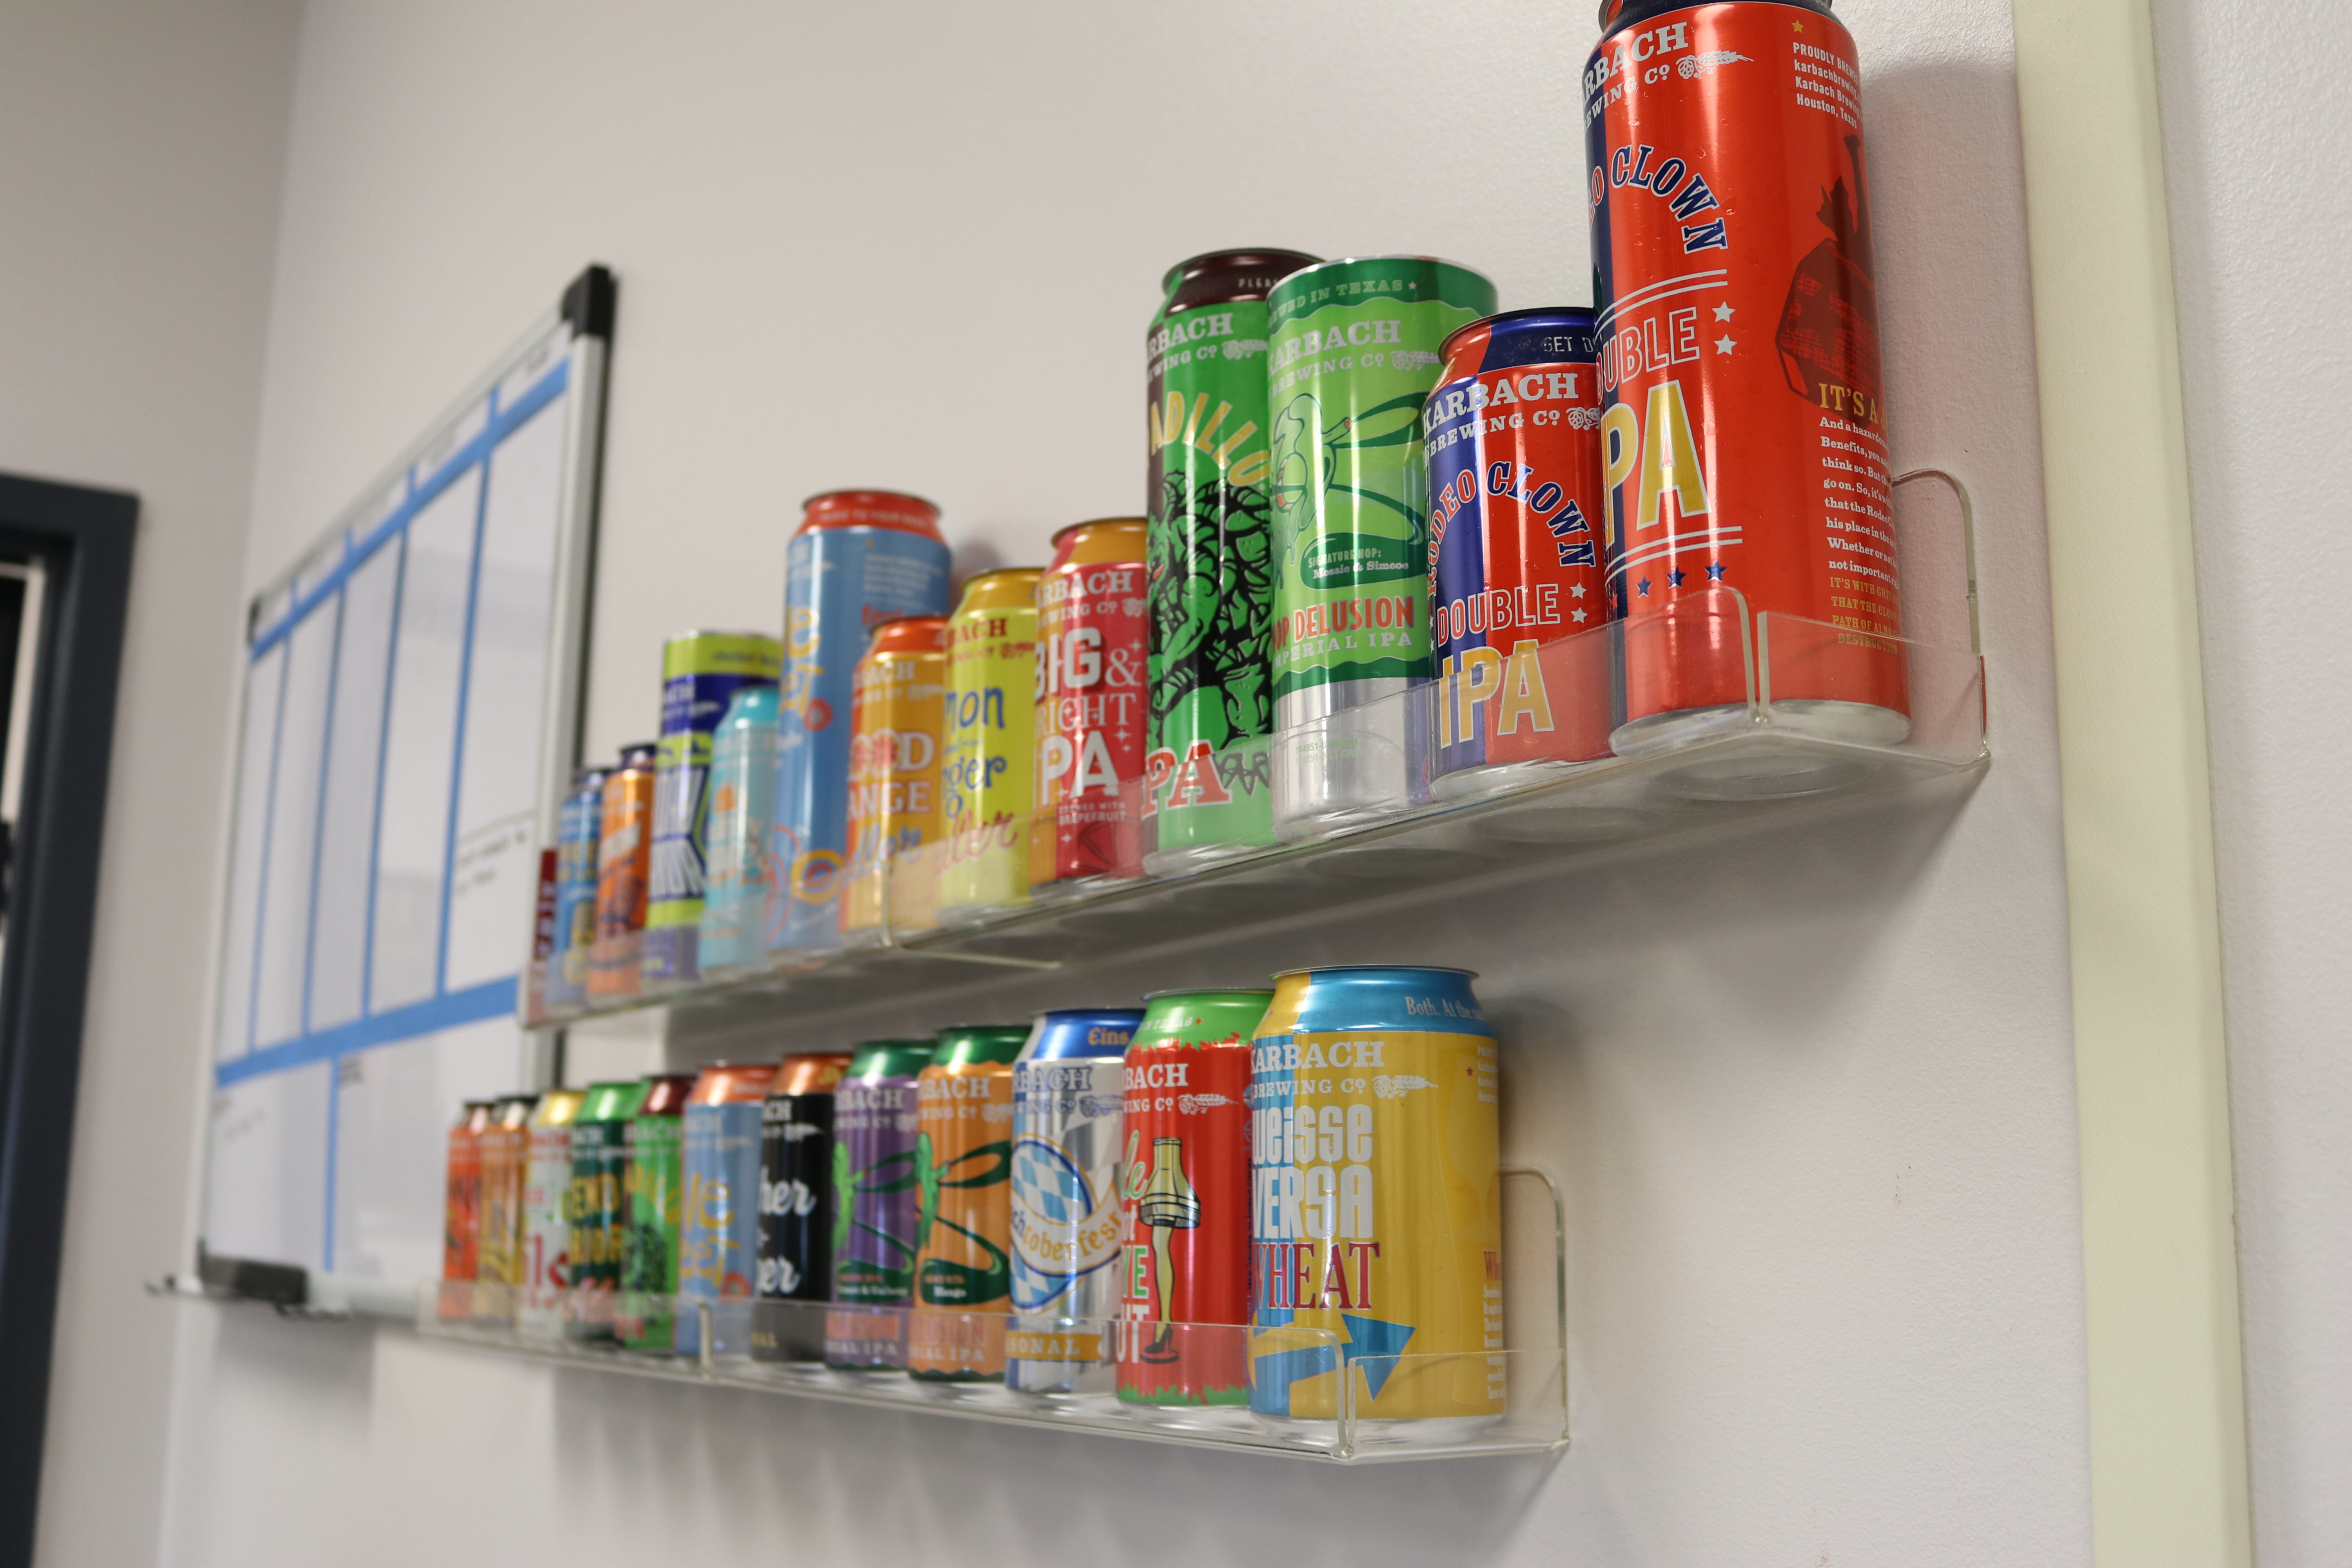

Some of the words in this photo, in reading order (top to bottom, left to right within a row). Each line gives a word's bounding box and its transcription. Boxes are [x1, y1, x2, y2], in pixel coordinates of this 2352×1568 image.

[1583, 22, 1688, 106] RBACH
[1793, 42, 1835, 65] PROUDLY
[1837, 57, 1859, 85] BREWE
[1585, 76, 1637, 131] EWING
[1795, 76, 1835, 98] Karbach
[1837, 89, 1860, 118] Brewing
[1797, 93, 1838, 118] Houston,
[1840, 107, 1857, 129] Texas
[1611, 144, 1728, 254] CLOWN
[1310, 287, 1330, 303] IN
[1336, 280, 1403, 296] TEXAS
[1544, 336, 1572, 352] GET
[1423, 373, 1579, 439] KARBACH
[1819, 383, 1865, 416] IT'S
[1869, 398, 1878, 425] A
[1430, 412, 1524, 457] BREWING
[1820, 416, 1844, 430] And
[1845, 423, 1852, 432] a
[1821, 436, 1867, 457] Benefits,
[1868, 450, 1880, 463] you
[1822, 457, 1853, 471] think
[1854, 465, 1866, 475] so.
[1867, 466, 1881, 481] But
[1824, 478, 1837, 489] go
[1838, 481, 1855, 491] on.
[1857, 483, 1870, 497] So,
[1871, 488, 1882, 500] it's
[1824, 497, 1849, 510] that
[1851, 501, 1866, 514] the
[1867, 505, 1887, 524] Rodeo
[1428, 469, 1477, 597] RODEO
[1487, 461, 1596, 568] CLOWN
[1826, 516, 1844, 528] his
[1846, 519, 1870, 535] place
[1871, 527, 1879, 538] in
[1308, 550, 1354, 568] SIGNATURE
[1827, 537, 1874, 556] Whether
[1875, 549, 1883, 559] or
[1313, 564, 1350, 579] Mosaic
[1353, 562, 1363, 572] &
[1367, 561, 1409, 571] Simcoe
[1829, 561, 1848, 570] not
[1850, 560, 1891, 583] important
[1830, 577, 1851, 589] IT'S
[1853, 580, 1875, 595] WITH
[1437, 583, 1560, 647] DOUBLE
[1831, 596, 1858, 609] THAT
[1860, 600, 1877, 613] THE
[1293, 595, 1414, 643] DELUSION
[1832, 615, 1858, 628] PATH
[1861, 619, 1871, 630] OF
[1368, 632, 1413, 648] IPA
[1105, 648, 1142, 687] &
[1439, 639, 1555, 749] IPA
[1405, 996, 1441, 1015] Both.
[1442, 998, 1457, 1017] At
[1251, 1079, 1333, 1099] BREWING
[1006, 1337, 1080, 1357] SONAL
